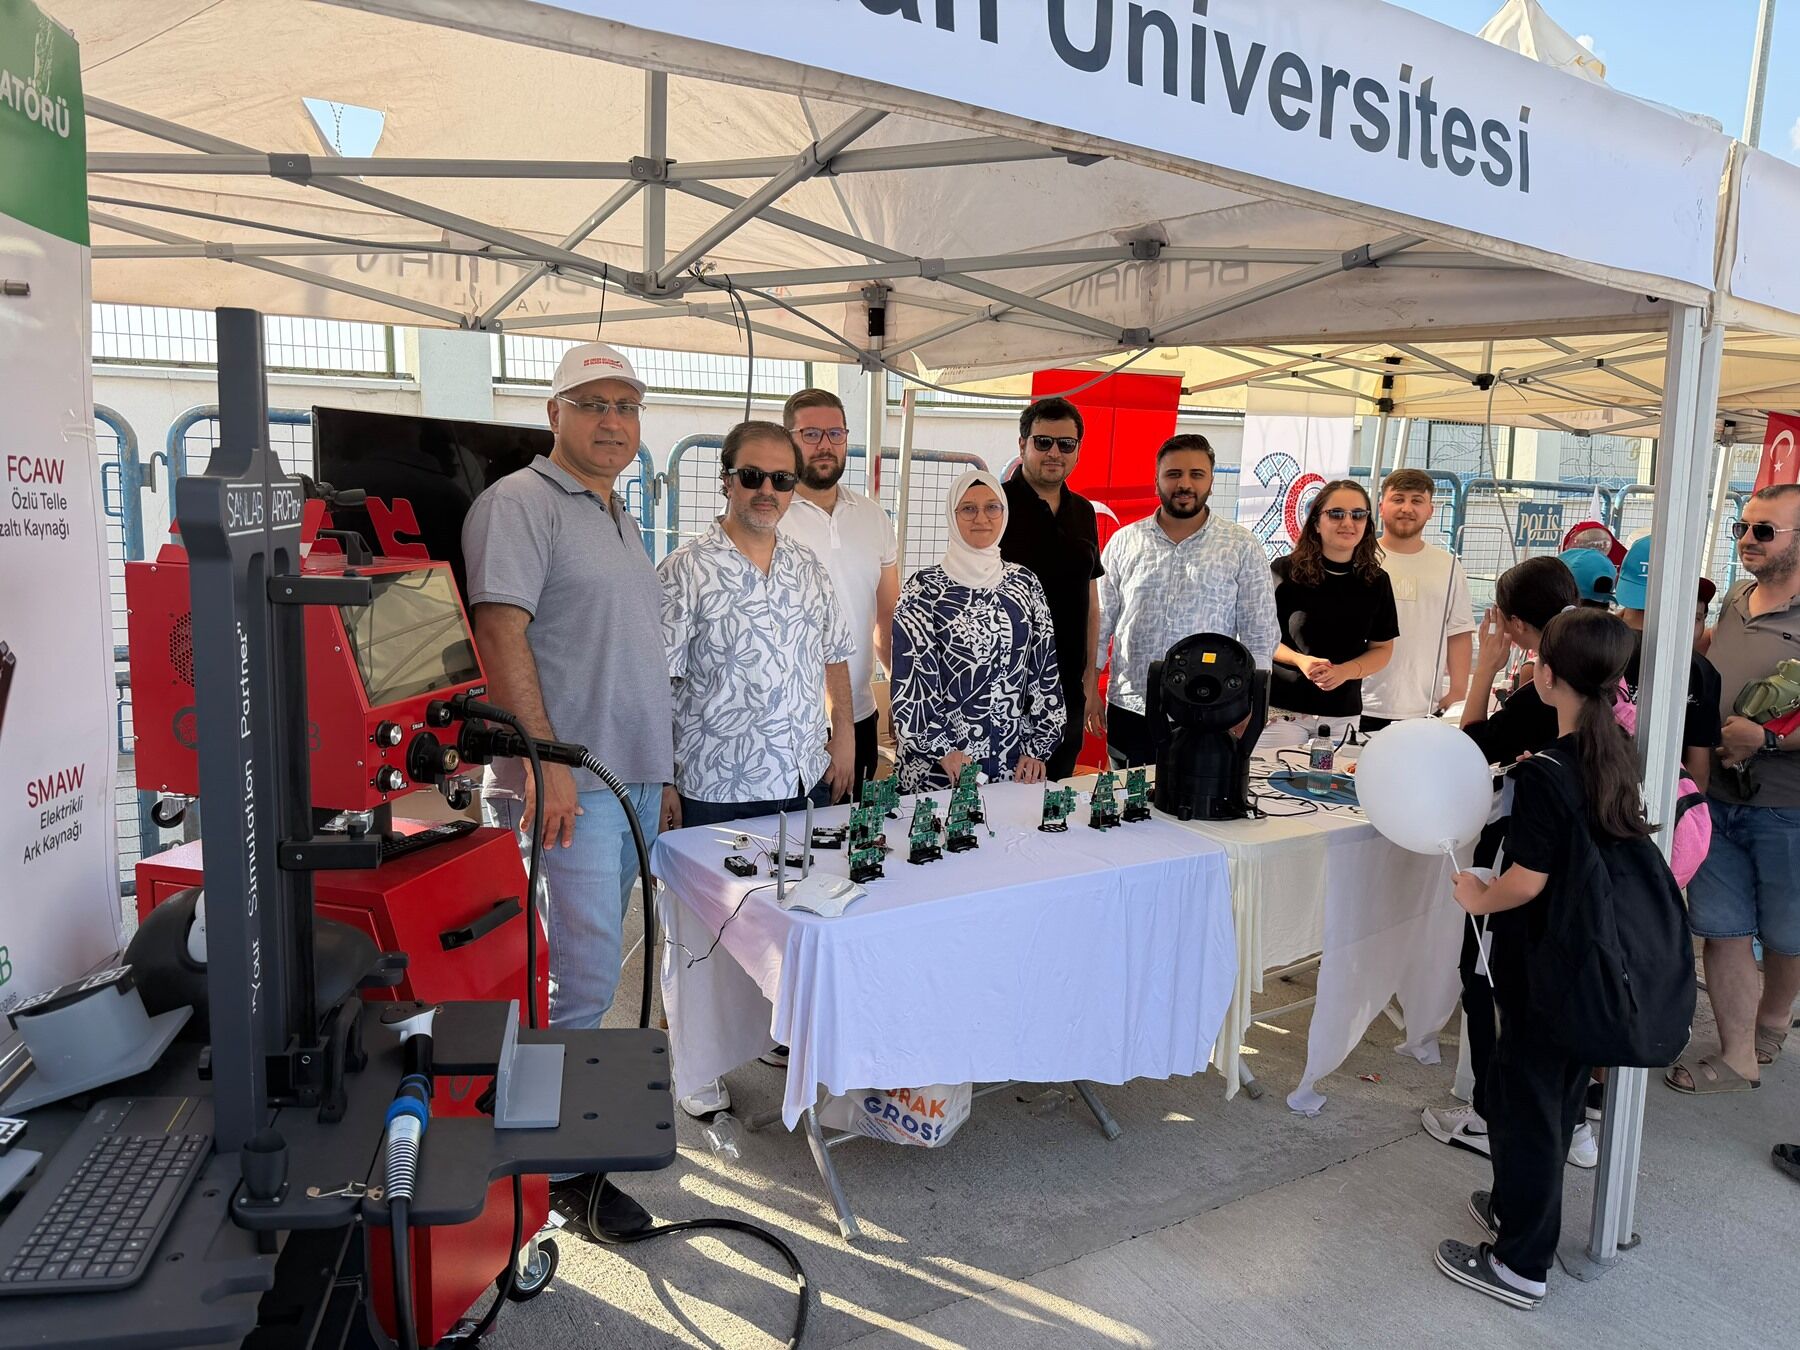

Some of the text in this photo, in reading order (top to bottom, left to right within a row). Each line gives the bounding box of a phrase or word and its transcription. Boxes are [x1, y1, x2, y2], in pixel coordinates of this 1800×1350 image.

[7, 455, 65, 484] FCAW
[11, 487, 67, 510] Özlü Telle
[227, 491, 264, 528] SANLAB
[24, 518, 70, 540] Kaynağı
[1517, 507, 1560, 541] POLİS
[27, 763, 85, 809] SMAW
[40, 795, 84, 830] Elektrikli
[24, 821, 82, 864] Ark Kaynağı
[244, 759, 258, 917] Simulation
